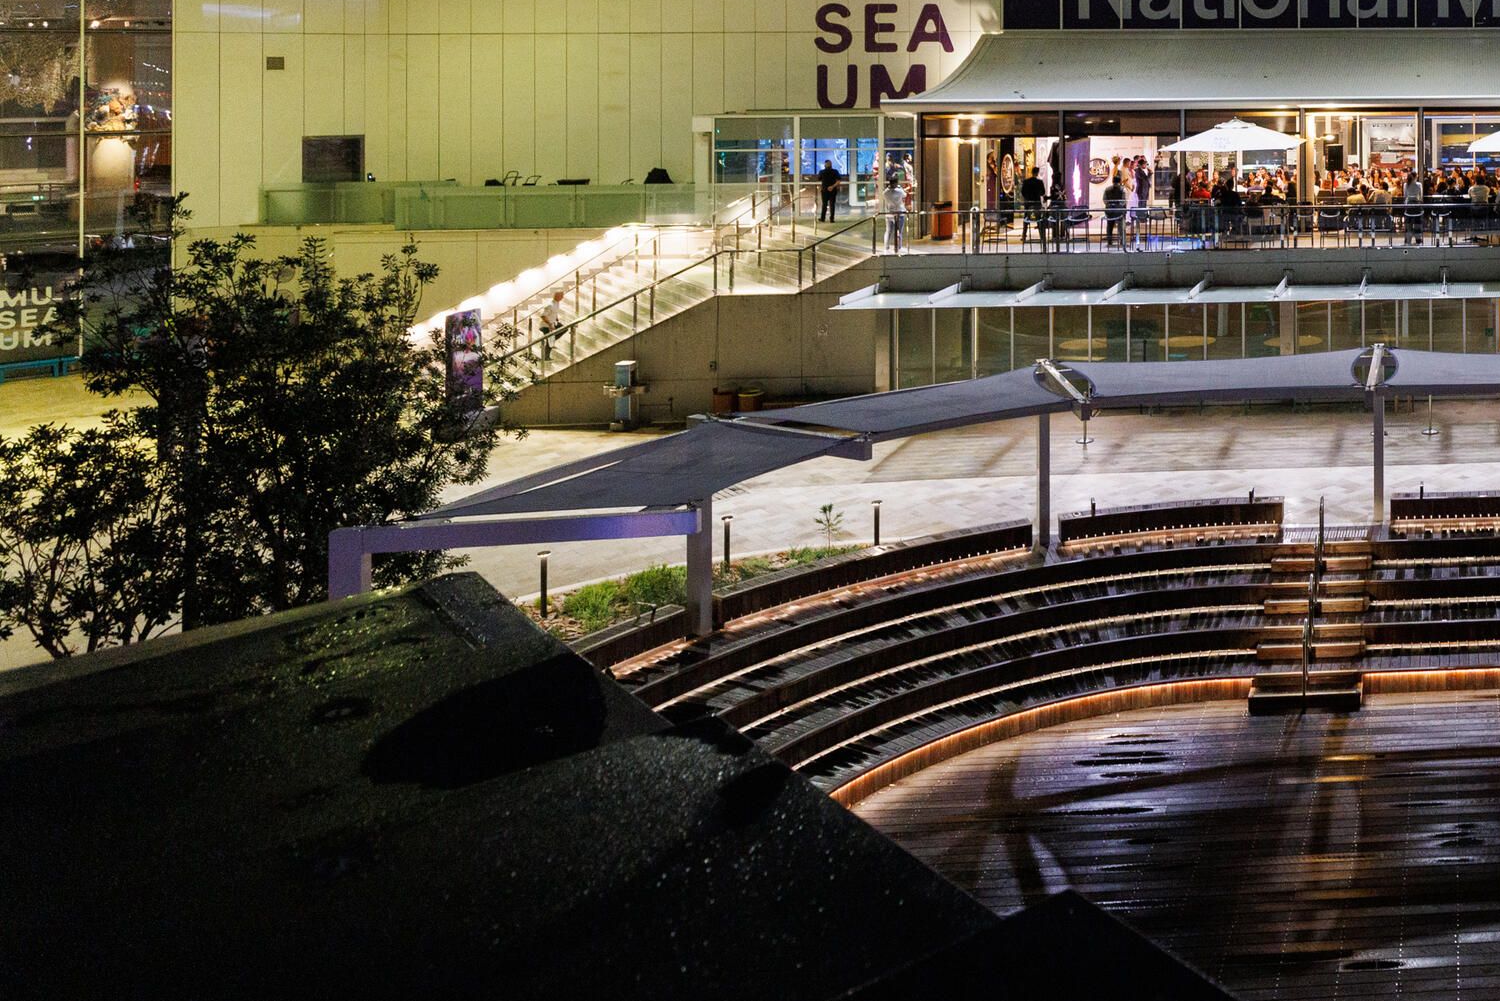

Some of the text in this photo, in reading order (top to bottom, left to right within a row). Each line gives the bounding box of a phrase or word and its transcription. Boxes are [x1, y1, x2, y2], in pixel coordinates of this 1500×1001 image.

[814, 3, 954, 53] SEA
[817, 64, 927, 109] UM
[0, 286, 53, 309] MU
